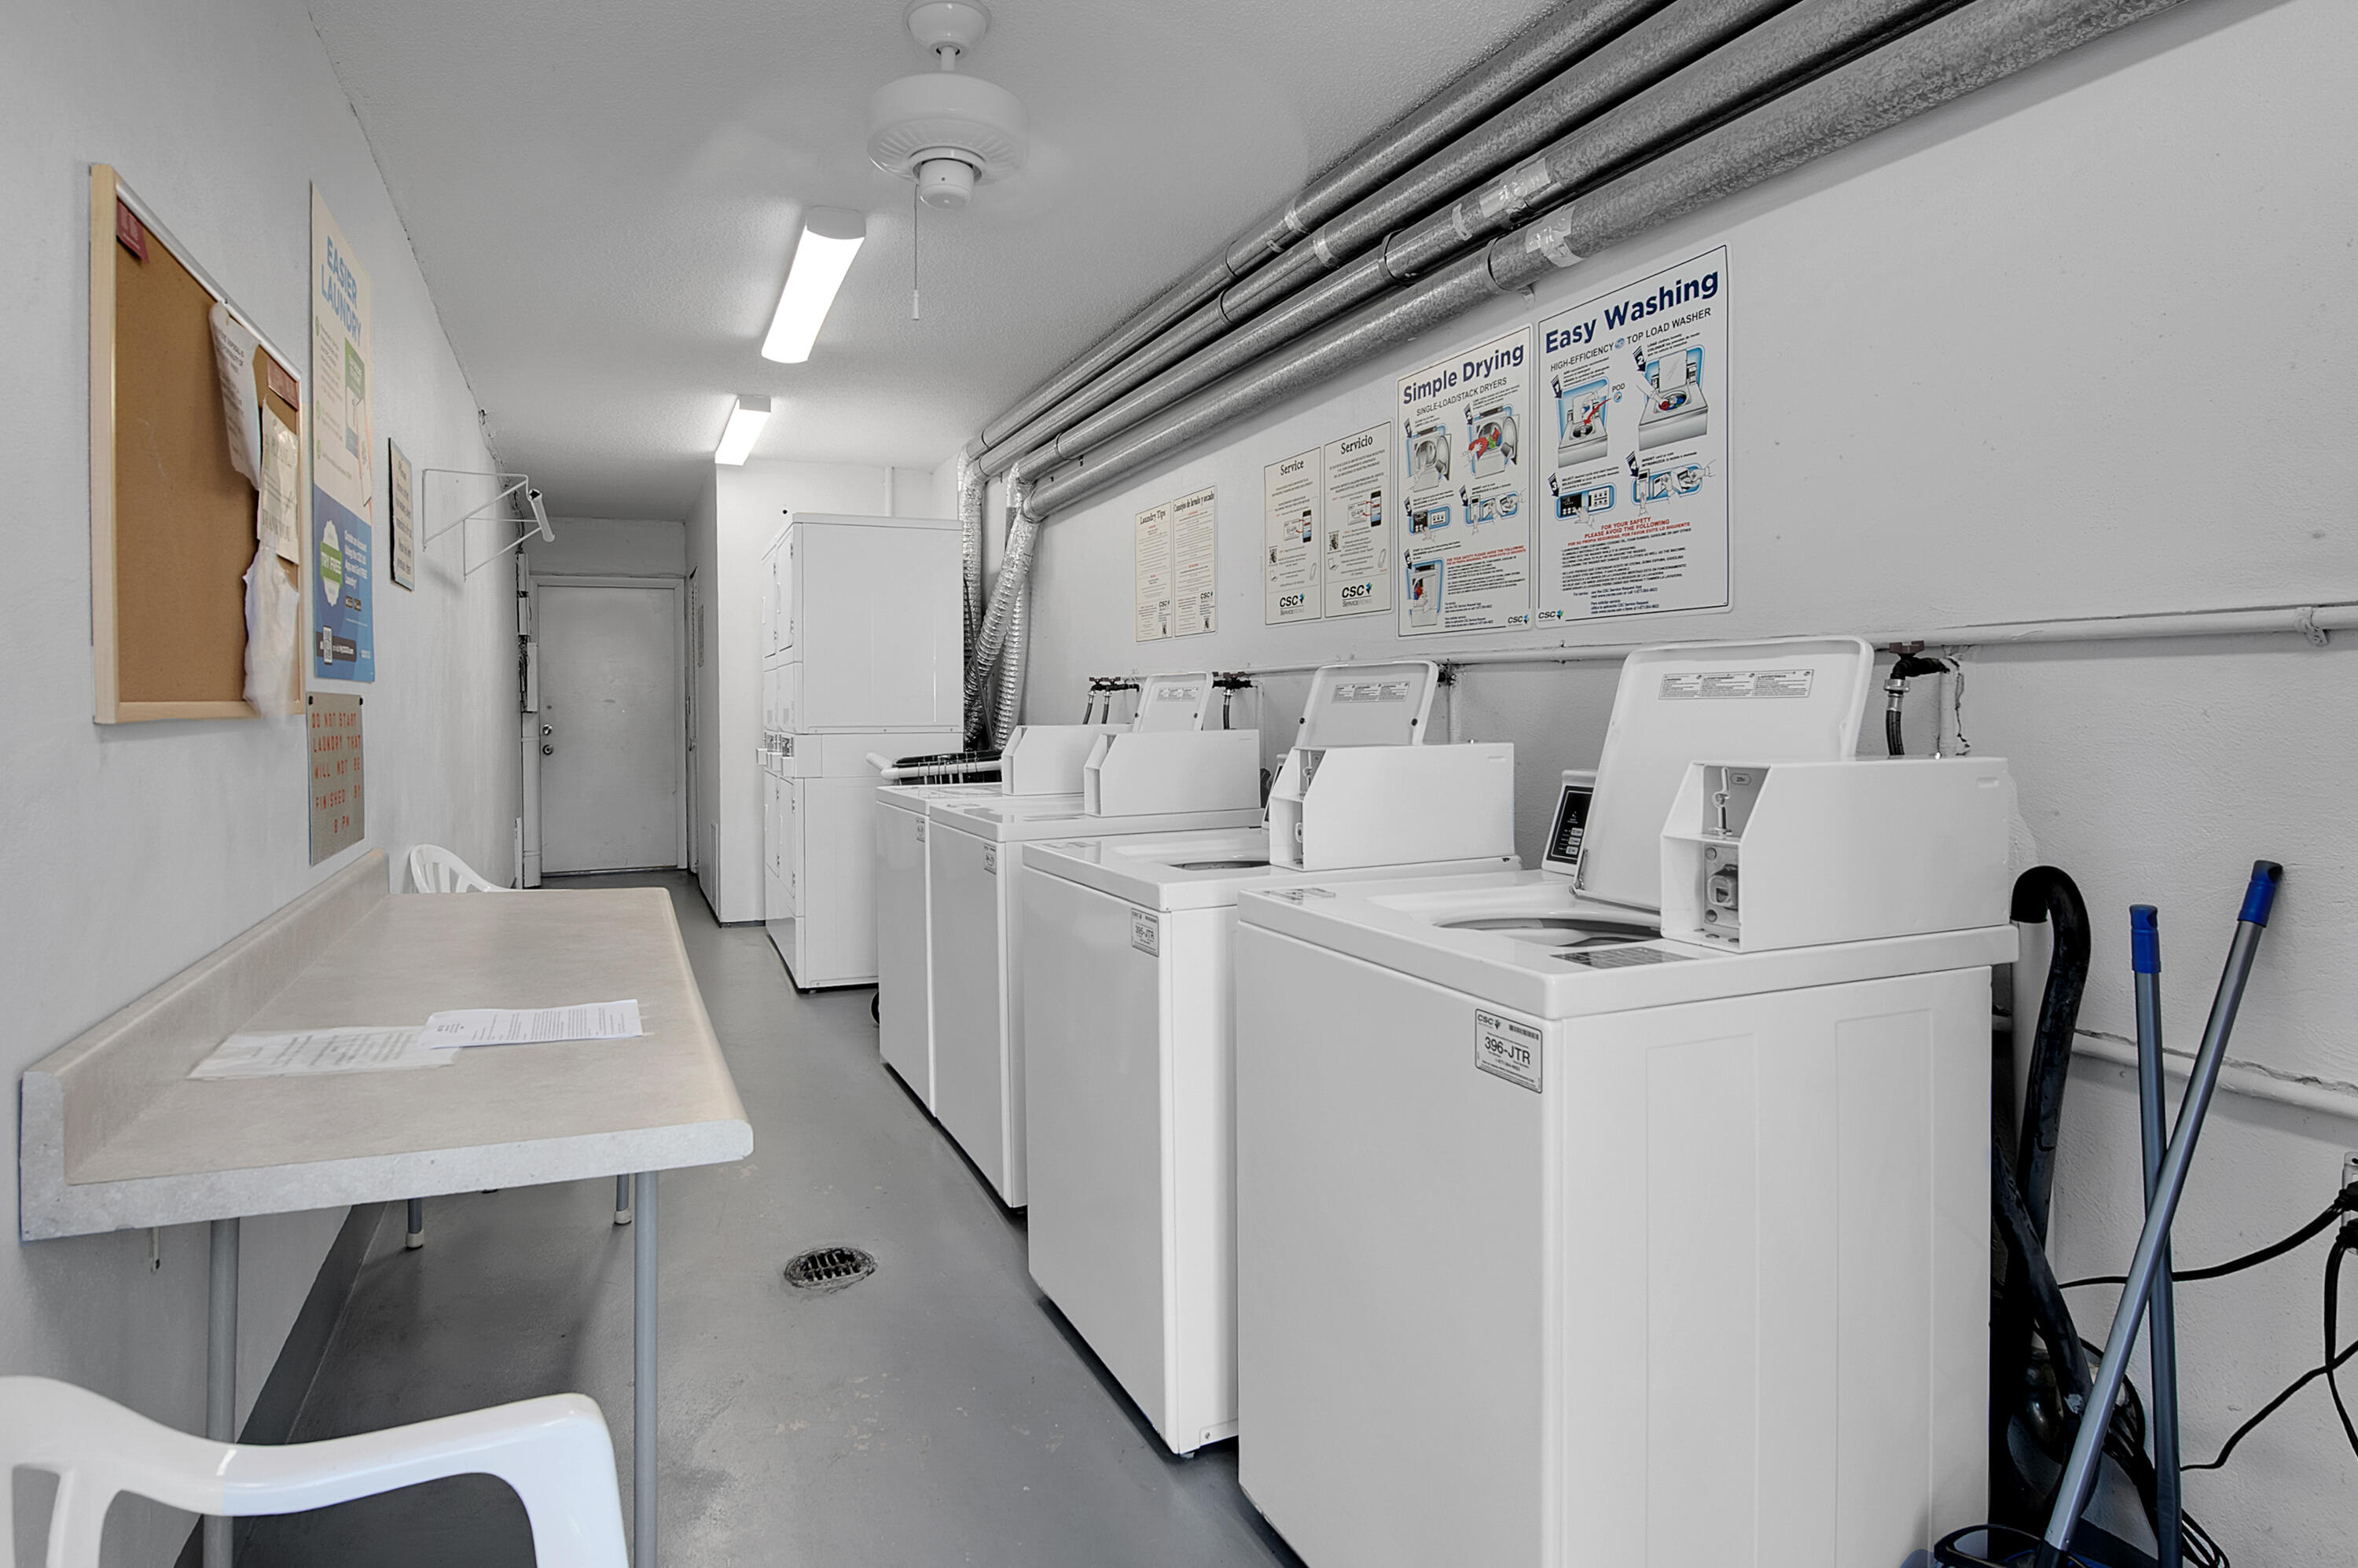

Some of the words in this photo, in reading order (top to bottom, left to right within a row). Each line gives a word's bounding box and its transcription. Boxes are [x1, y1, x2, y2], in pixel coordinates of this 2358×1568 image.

[327, 235, 358, 310] EASIER
[321, 263, 362, 347] LAUNDRY
[1545, 318, 1596, 354] Easy
[1604, 271, 1718, 331] Washing
[1550, 343, 1614, 372] HIGH-EFFICIENCY
[1626, 332, 1644, 345] TOP
[1646, 322, 1669, 338] LOAD
[1672, 307, 1711, 329] WASHER
[1637, 355, 1644, 366] 2
[1403, 369, 1457, 405] Simple
[1463, 344, 1524, 383] Drying
[1611, 383, 1625, 392] POD
[1416, 387, 1478, 417] SINGLE-LOAD/STACK
[1479, 377, 1508, 394] DRYERS
[1341, 435, 1374, 454] Servicio
[1280, 460, 1305, 476] Service
[1551, 481, 1557, 491] 3
[1140, 512, 1155, 525] Laundry
[1156, 509, 1166, 520] Tips
[1629, 516, 1651, 526] SAFETY
[1636, 519, 1670, 530] FOLLOWING
[321, 551, 329, 567] TRY
[330, 556, 341, 575] FREE
[1342, 585, 1364, 598] CSC
[1280, 595, 1298, 608] CSC
[312, 713, 321, 729] DO
[324, 712, 336, 727] NOT
[339, 712, 357, 727] START
[313, 735, 342, 753] LAUNDRY
[347, 734, 361, 749] THAT
[314, 763, 330, 780] WILL
[336, 759, 348, 774] NOT
[354, 757, 361, 771] BE
[316, 789, 345, 811] FINISHED
[354, 784, 361, 799] BY
[342, 815, 351, 830] PM
[1478, 1014, 1494, 1025] CSC
[1485, 1036, 1531, 1065] 396-JTR
